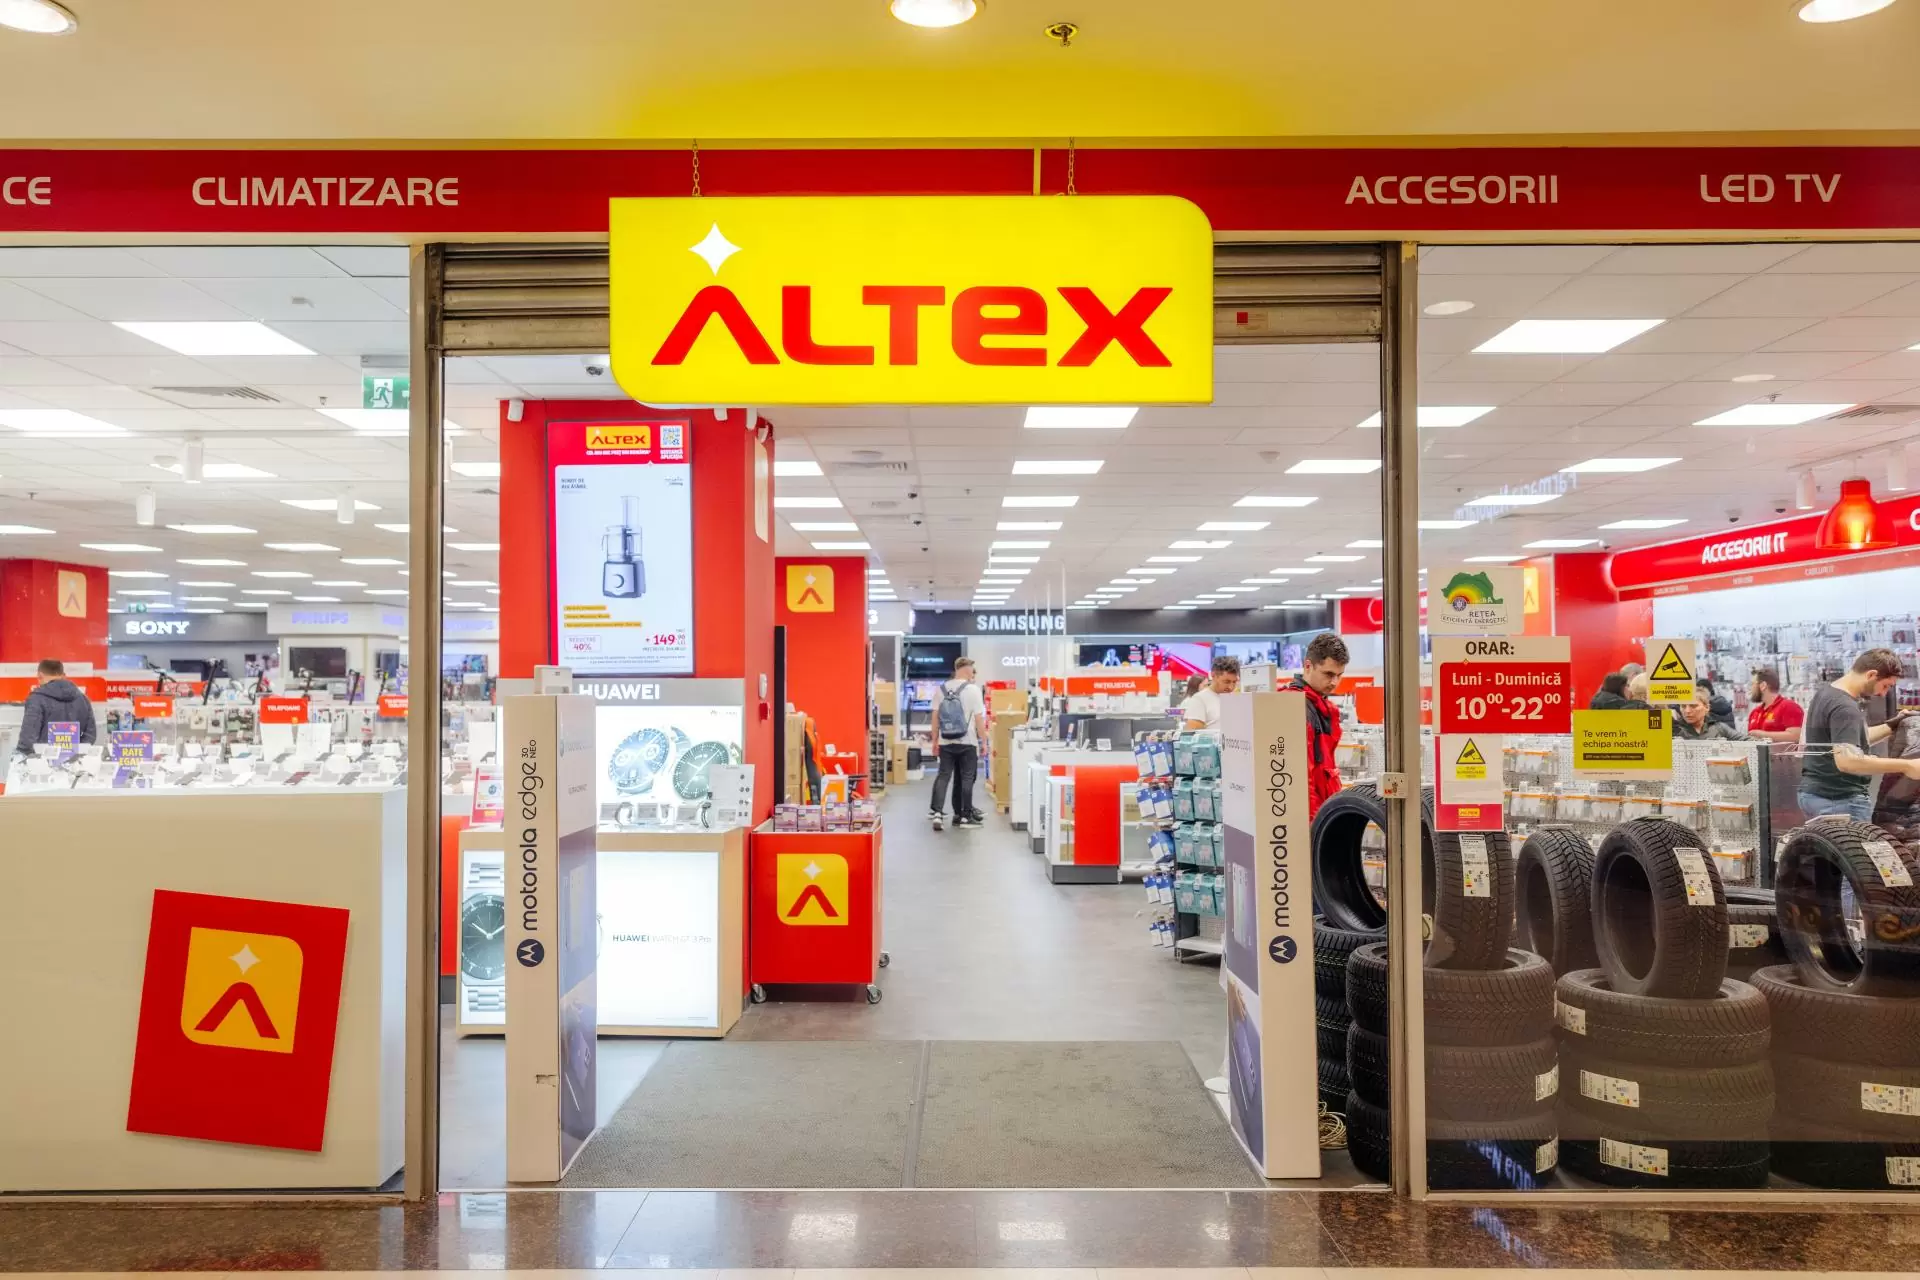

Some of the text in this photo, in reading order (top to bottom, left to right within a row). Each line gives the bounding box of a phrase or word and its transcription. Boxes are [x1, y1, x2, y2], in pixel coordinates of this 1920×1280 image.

[192, 177, 460, 206] CLIMATIZARE
[1345, 175, 1559, 205] ACCESORII
[1700, 174, 1841, 204] LED TV
[650, 285, 1173, 368] ALTEX
[1702, 532, 1789, 565] ACCESORII IT
[292, 611, 349, 625] PHILIPS
[976, 614, 1066, 631] SAMSUNG
[125, 620, 190, 635] SONY
[1465, 641, 1515, 655] ORAR:
[1001, 656, 1041, 666] QLED TV
[1452, 672, 1482, 686] Luni
[1495, 672, 1561, 686] Duminică
[579, 684, 661, 700] HUAWEI
[1583, 730, 1593, 738] Te
[1619, 730, 1628, 738] în
[529, 739, 537, 759] NEO
[1583, 740, 1648, 748] echipa noastră!
[122, 748, 144, 757] RATE
[517, 747, 544, 931] motorola edge 30
[1266, 744, 1293, 928] motorola edge 30
